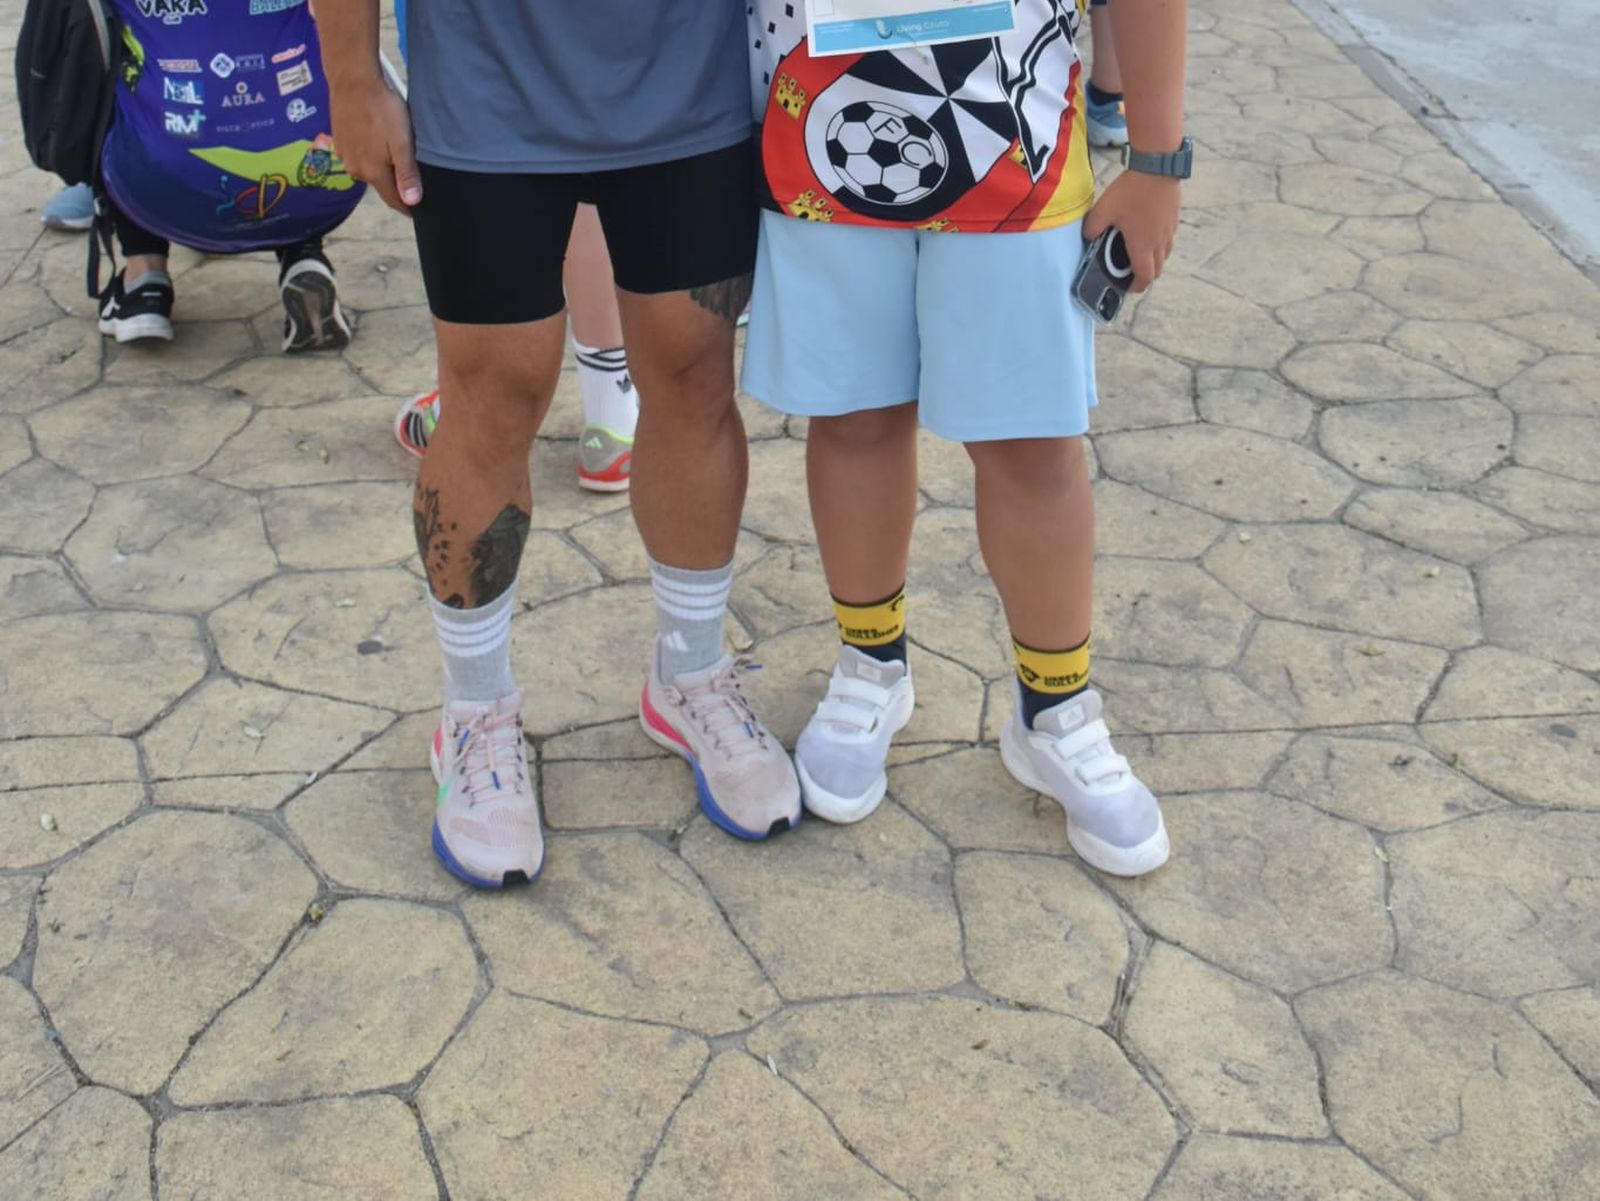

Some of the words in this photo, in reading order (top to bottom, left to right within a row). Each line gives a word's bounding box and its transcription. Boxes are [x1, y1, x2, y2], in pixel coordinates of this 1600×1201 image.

[222, 91, 265, 107] AURA
[874, 117, 902, 133] F
[901, 141, 932, 166] C
